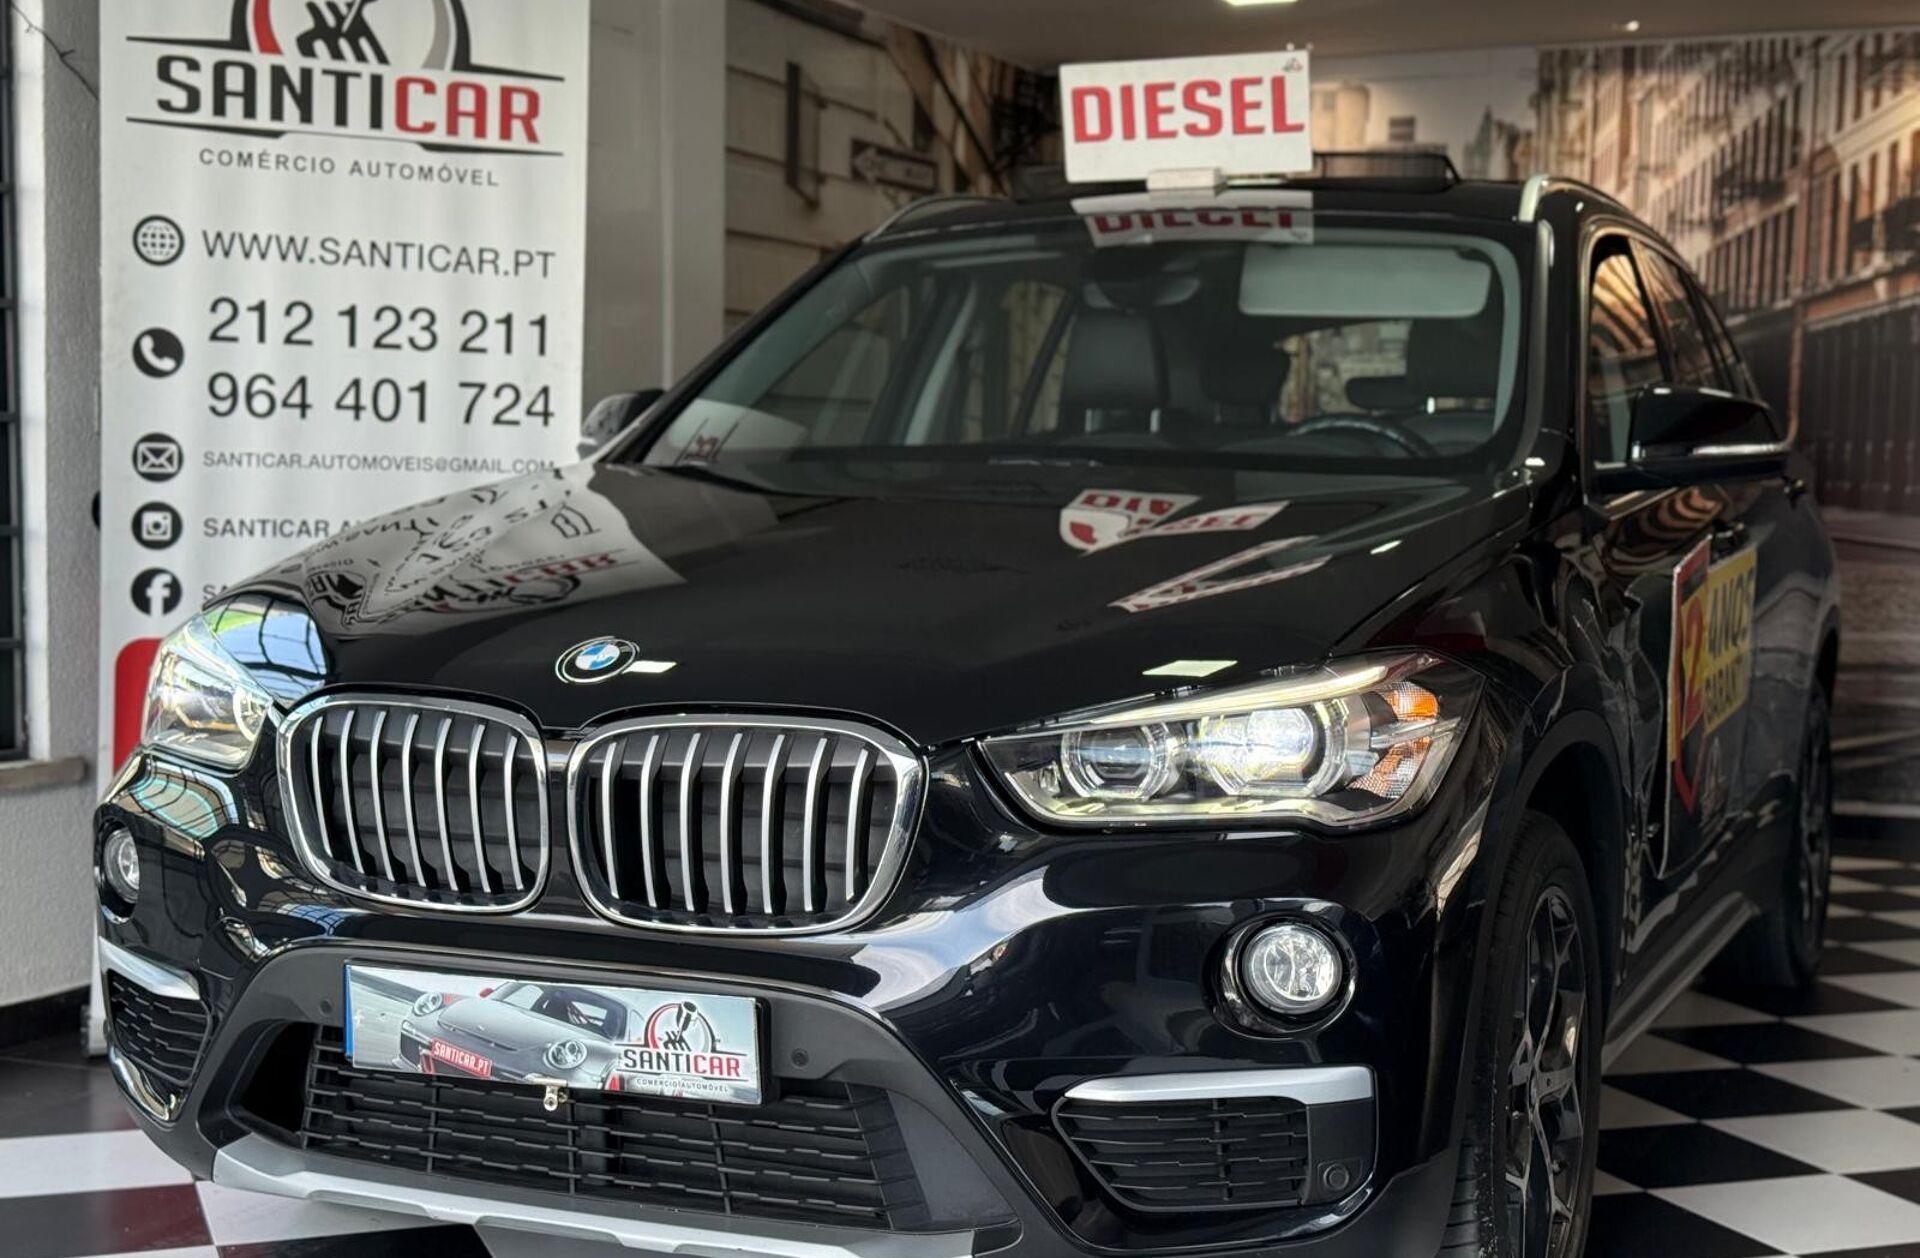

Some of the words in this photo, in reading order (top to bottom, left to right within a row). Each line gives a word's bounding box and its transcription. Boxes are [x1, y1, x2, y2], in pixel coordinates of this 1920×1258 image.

[156, 54, 541, 144] SANTICAR
[1070, 75, 1305, 143] DIESEL
[199, 148, 337, 175] COMÉRCIO
[349, 159, 500, 187] AUTOMÓVEL
[202, 229, 556, 279] WWW.SANTICAR.PT
[208, 296, 314, 345] 212
[337, 304, 438, 351] 123
[459, 309, 547, 356] 211
[208, 371, 313, 419] 964
[334, 376, 426, 423] 401
[458, 382, 555, 428] 724
[202, 517, 331, 539] SANTICAR
[433, 1041, 490, 1076] SANTICAR.PT
[623, 1049, 741, 1078] SANTICAR
